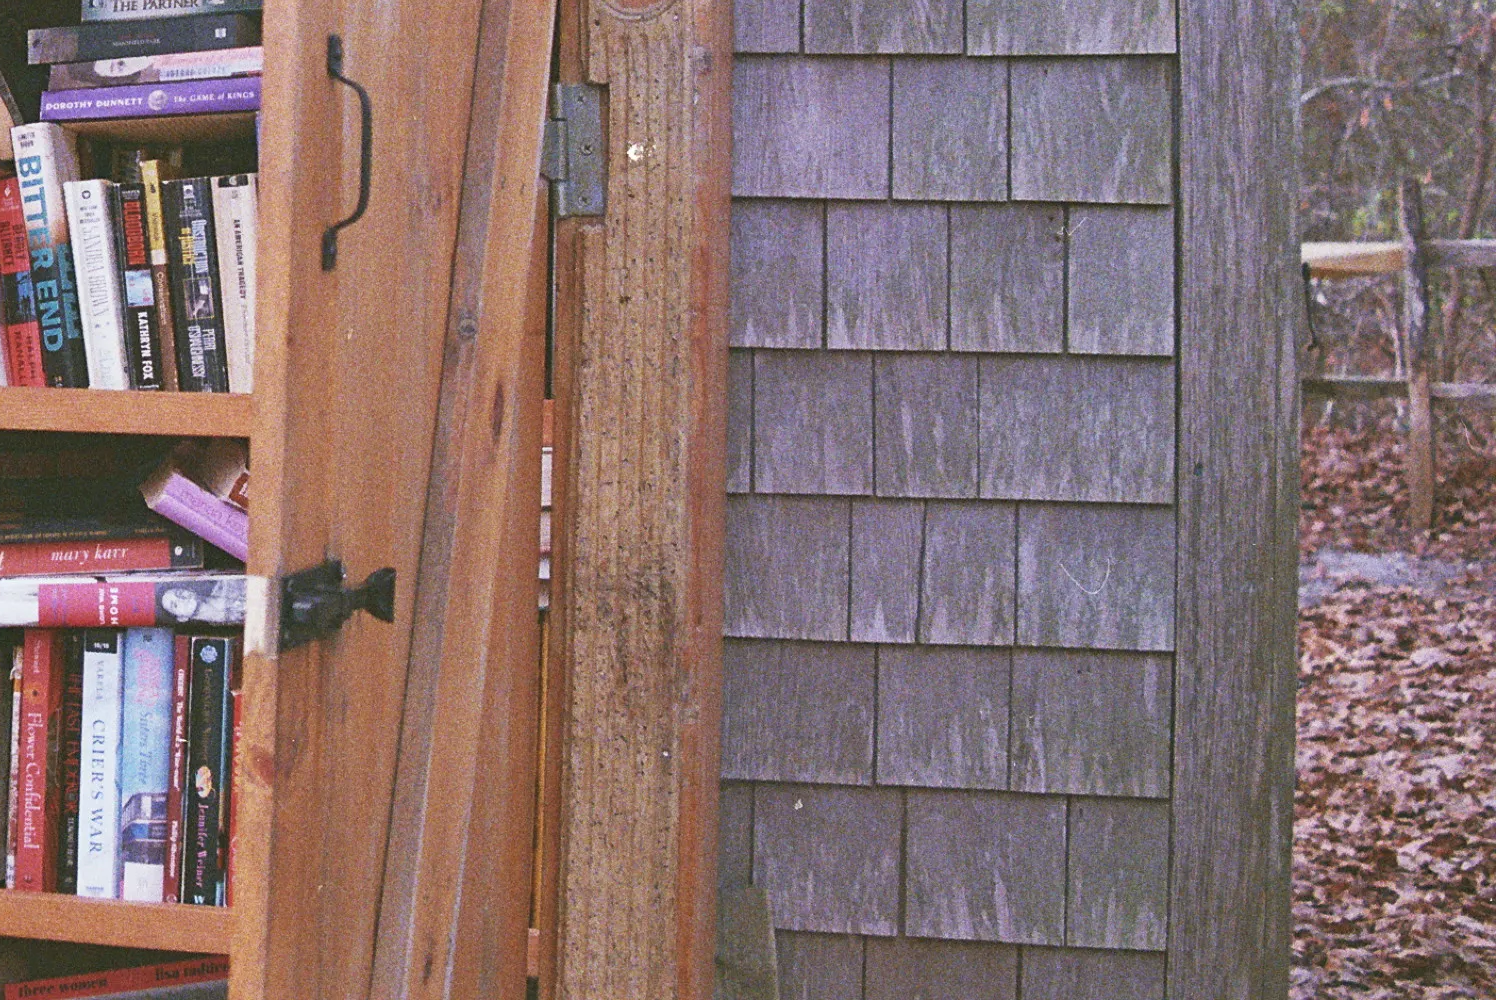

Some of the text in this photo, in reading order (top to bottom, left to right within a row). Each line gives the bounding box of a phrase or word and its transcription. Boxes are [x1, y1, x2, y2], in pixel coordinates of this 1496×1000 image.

[45, 97, 143, 111] DOROTHY DUNNETT
[189, 93, 216, 102] GAME
[227, 91, 255, 99] KINGS
[18, 155, 64, 352] BITTER END
[123, 202, 146, 266] BLOODBORN
[233, 219, 246, 300] AN AMERICAN TRAGEDY
[83, 225, 110, 318] SANDRA BROWN
[24, 335, 38, 379] RALPH
[137, 311, 154, 380] KATHRYN FOX
[204, 328, 216, 351] PERRI
[51, 546, 90, 566] mary
[94, 544, 130, 560] karr
[110, 586, 119, 626] HOME
[23, 711, 44, 850] Flower Confidential
[88, 719, 106, 853] CRIER'S WAR
[194, 803, 209, 888] Jennifer Weiner
[18, 984, 56, 999] three
[59, 978, 108, 994] women
